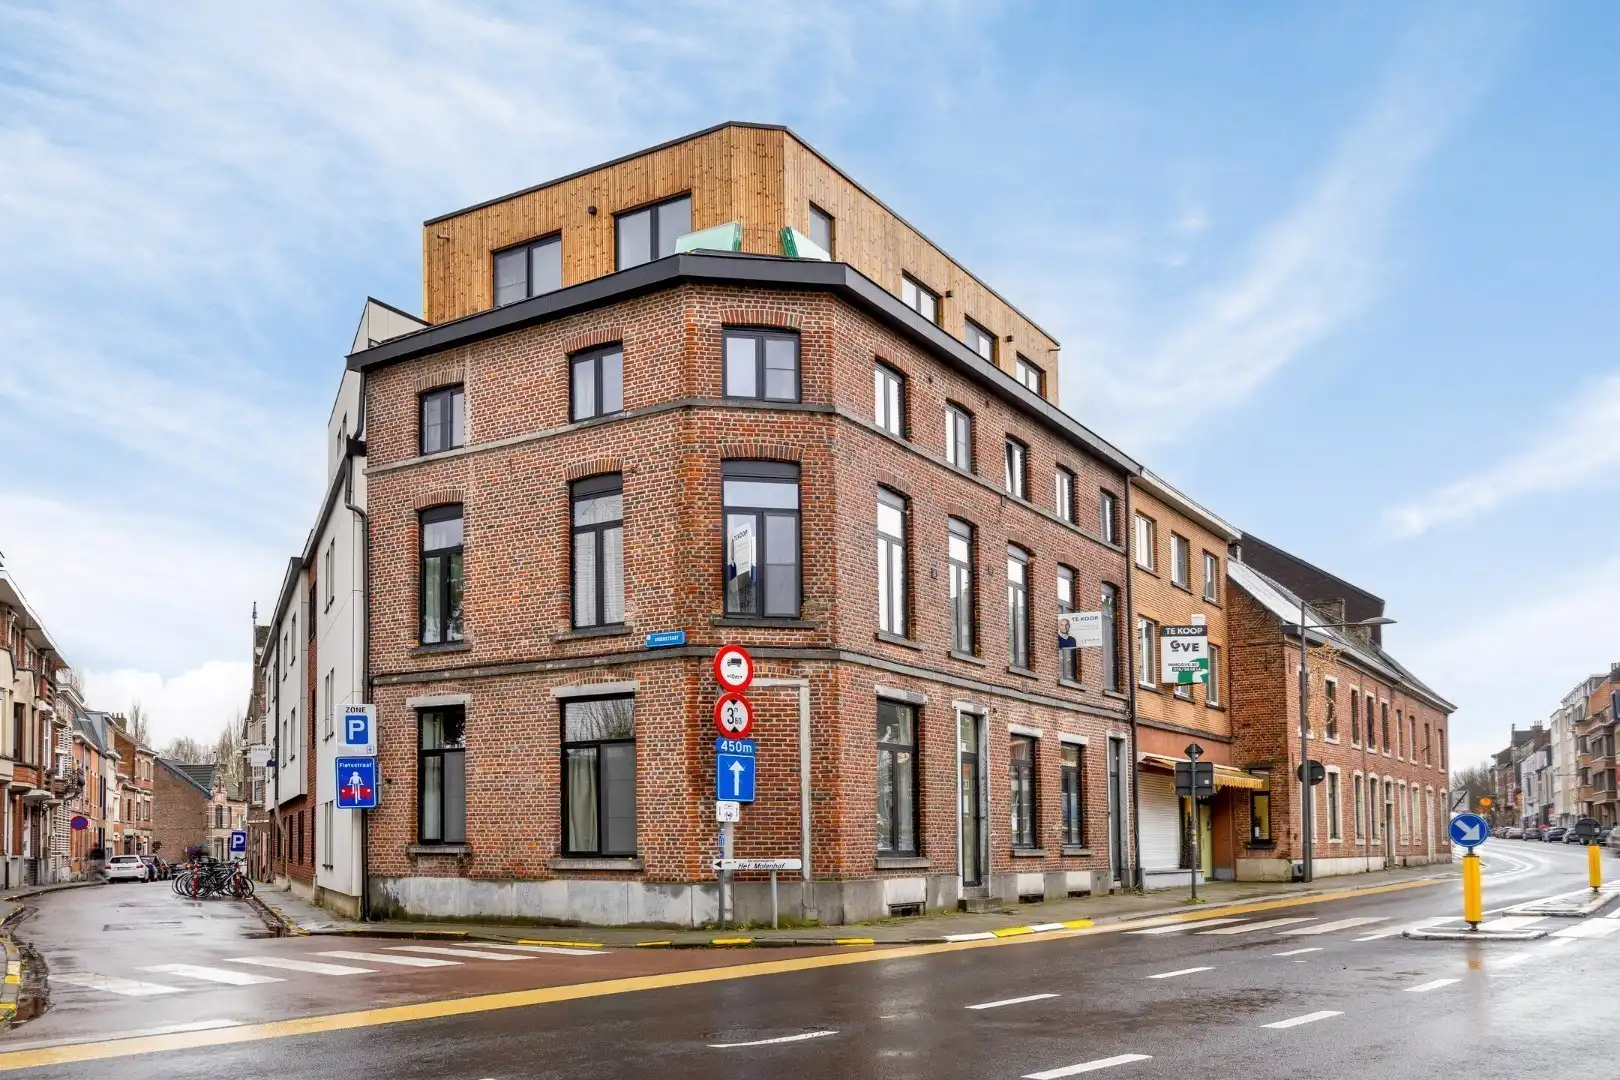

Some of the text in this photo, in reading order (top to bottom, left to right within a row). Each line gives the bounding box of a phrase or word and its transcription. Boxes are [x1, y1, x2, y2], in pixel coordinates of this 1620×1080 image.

[1165, 627, 1202, 635] TE KOOP
[345, 706, 367, 714] ZONE
[349, 720, 365, 740] P
[720, 741, 752, 753] 450m
[232, 834, 244, 849] P
